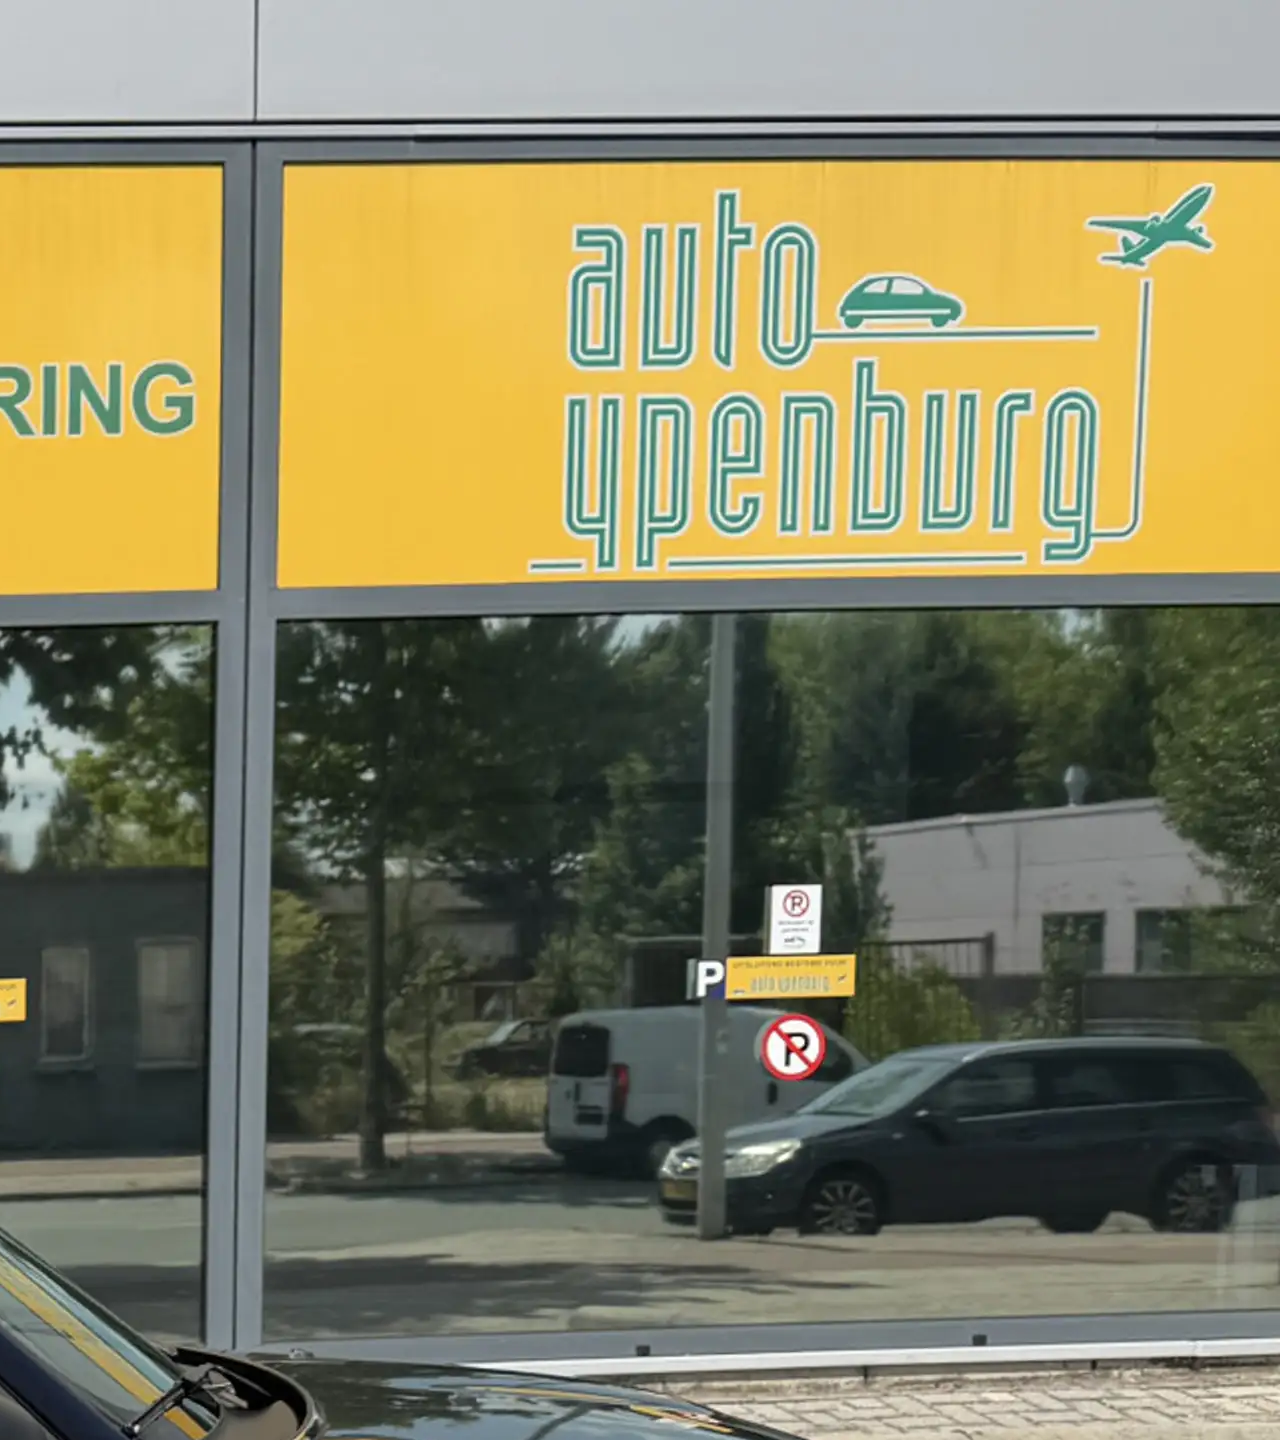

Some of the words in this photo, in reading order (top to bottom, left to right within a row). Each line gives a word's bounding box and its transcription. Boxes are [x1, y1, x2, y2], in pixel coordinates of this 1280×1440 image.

[566, 189, 816, 370] auto
[563, 358, 1099, 570] ypenburg
[696, 960, 725, 998] P
